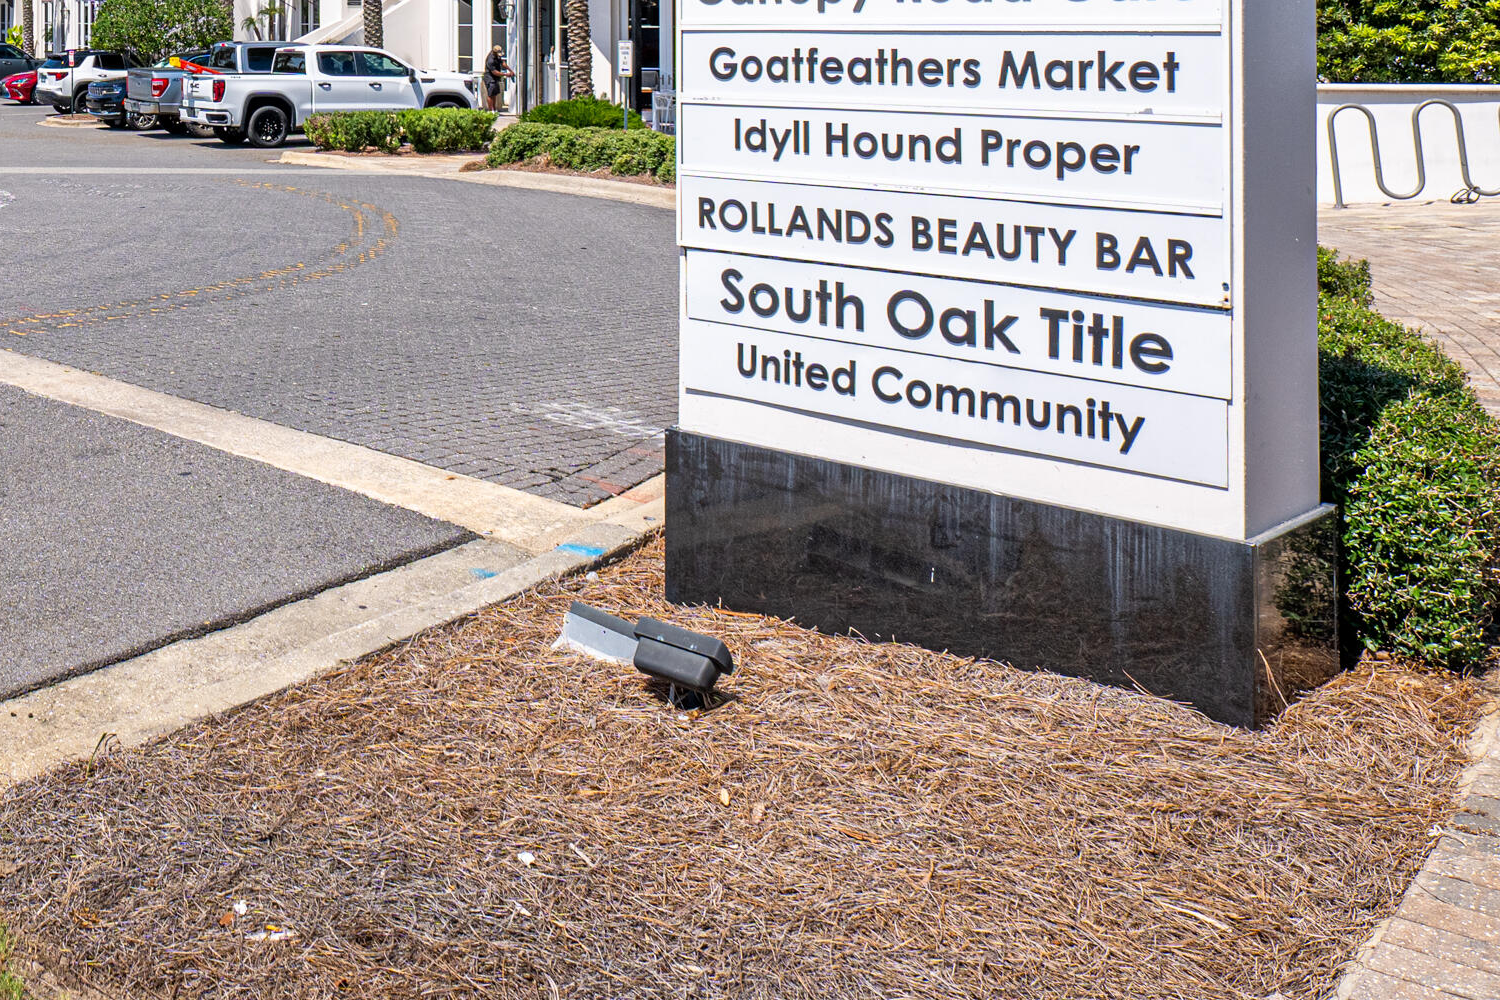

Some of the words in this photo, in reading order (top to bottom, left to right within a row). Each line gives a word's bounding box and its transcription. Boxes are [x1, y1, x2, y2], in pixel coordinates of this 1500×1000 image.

[708, 46, 981, 86] Goatfeathers
[998, 50, 1180, 92] Market
[734, 118, 810, 161] Idyll
[825, 122, 962, 164] Hound
[981, 129, 1140, 179] Proper
[698, 196, 894, 247] ROLLANDS
[911, 215, 1077, 265] BEAUTY
[1096, 232, 1196, 279] BAR
[720, 268, 864, 332] South
[887, 289, 1021, 355] Oak
[1039, 307, 1173, 373] Title
[737, 342, 856, 397] United
[871, 366, 1145, 454] Community
